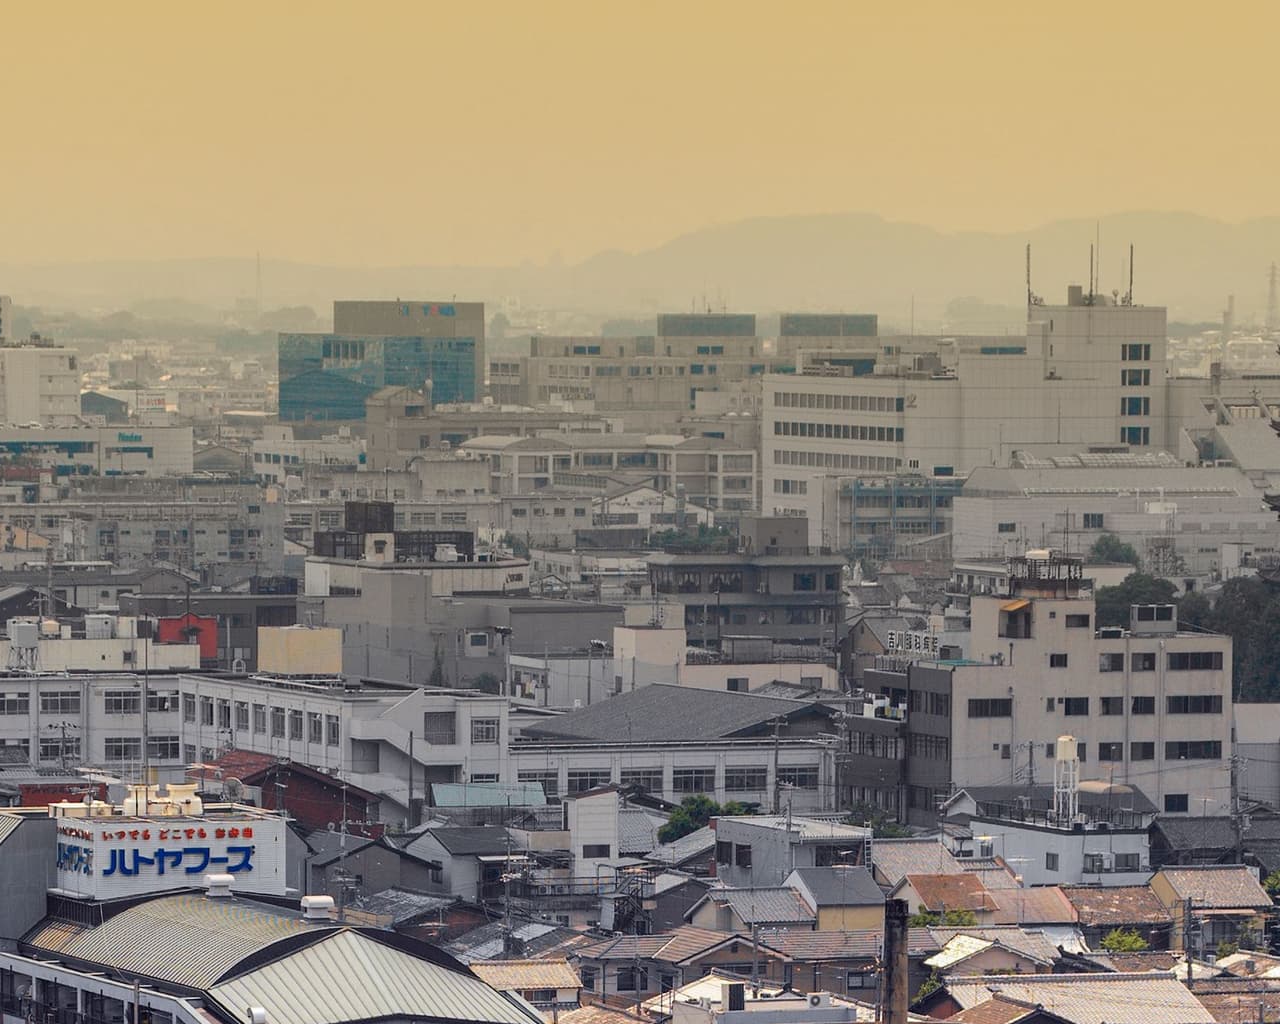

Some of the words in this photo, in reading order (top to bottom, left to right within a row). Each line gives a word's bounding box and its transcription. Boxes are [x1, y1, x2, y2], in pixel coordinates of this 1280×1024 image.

[102, 845, 255, 876] ハトヤフーズ
